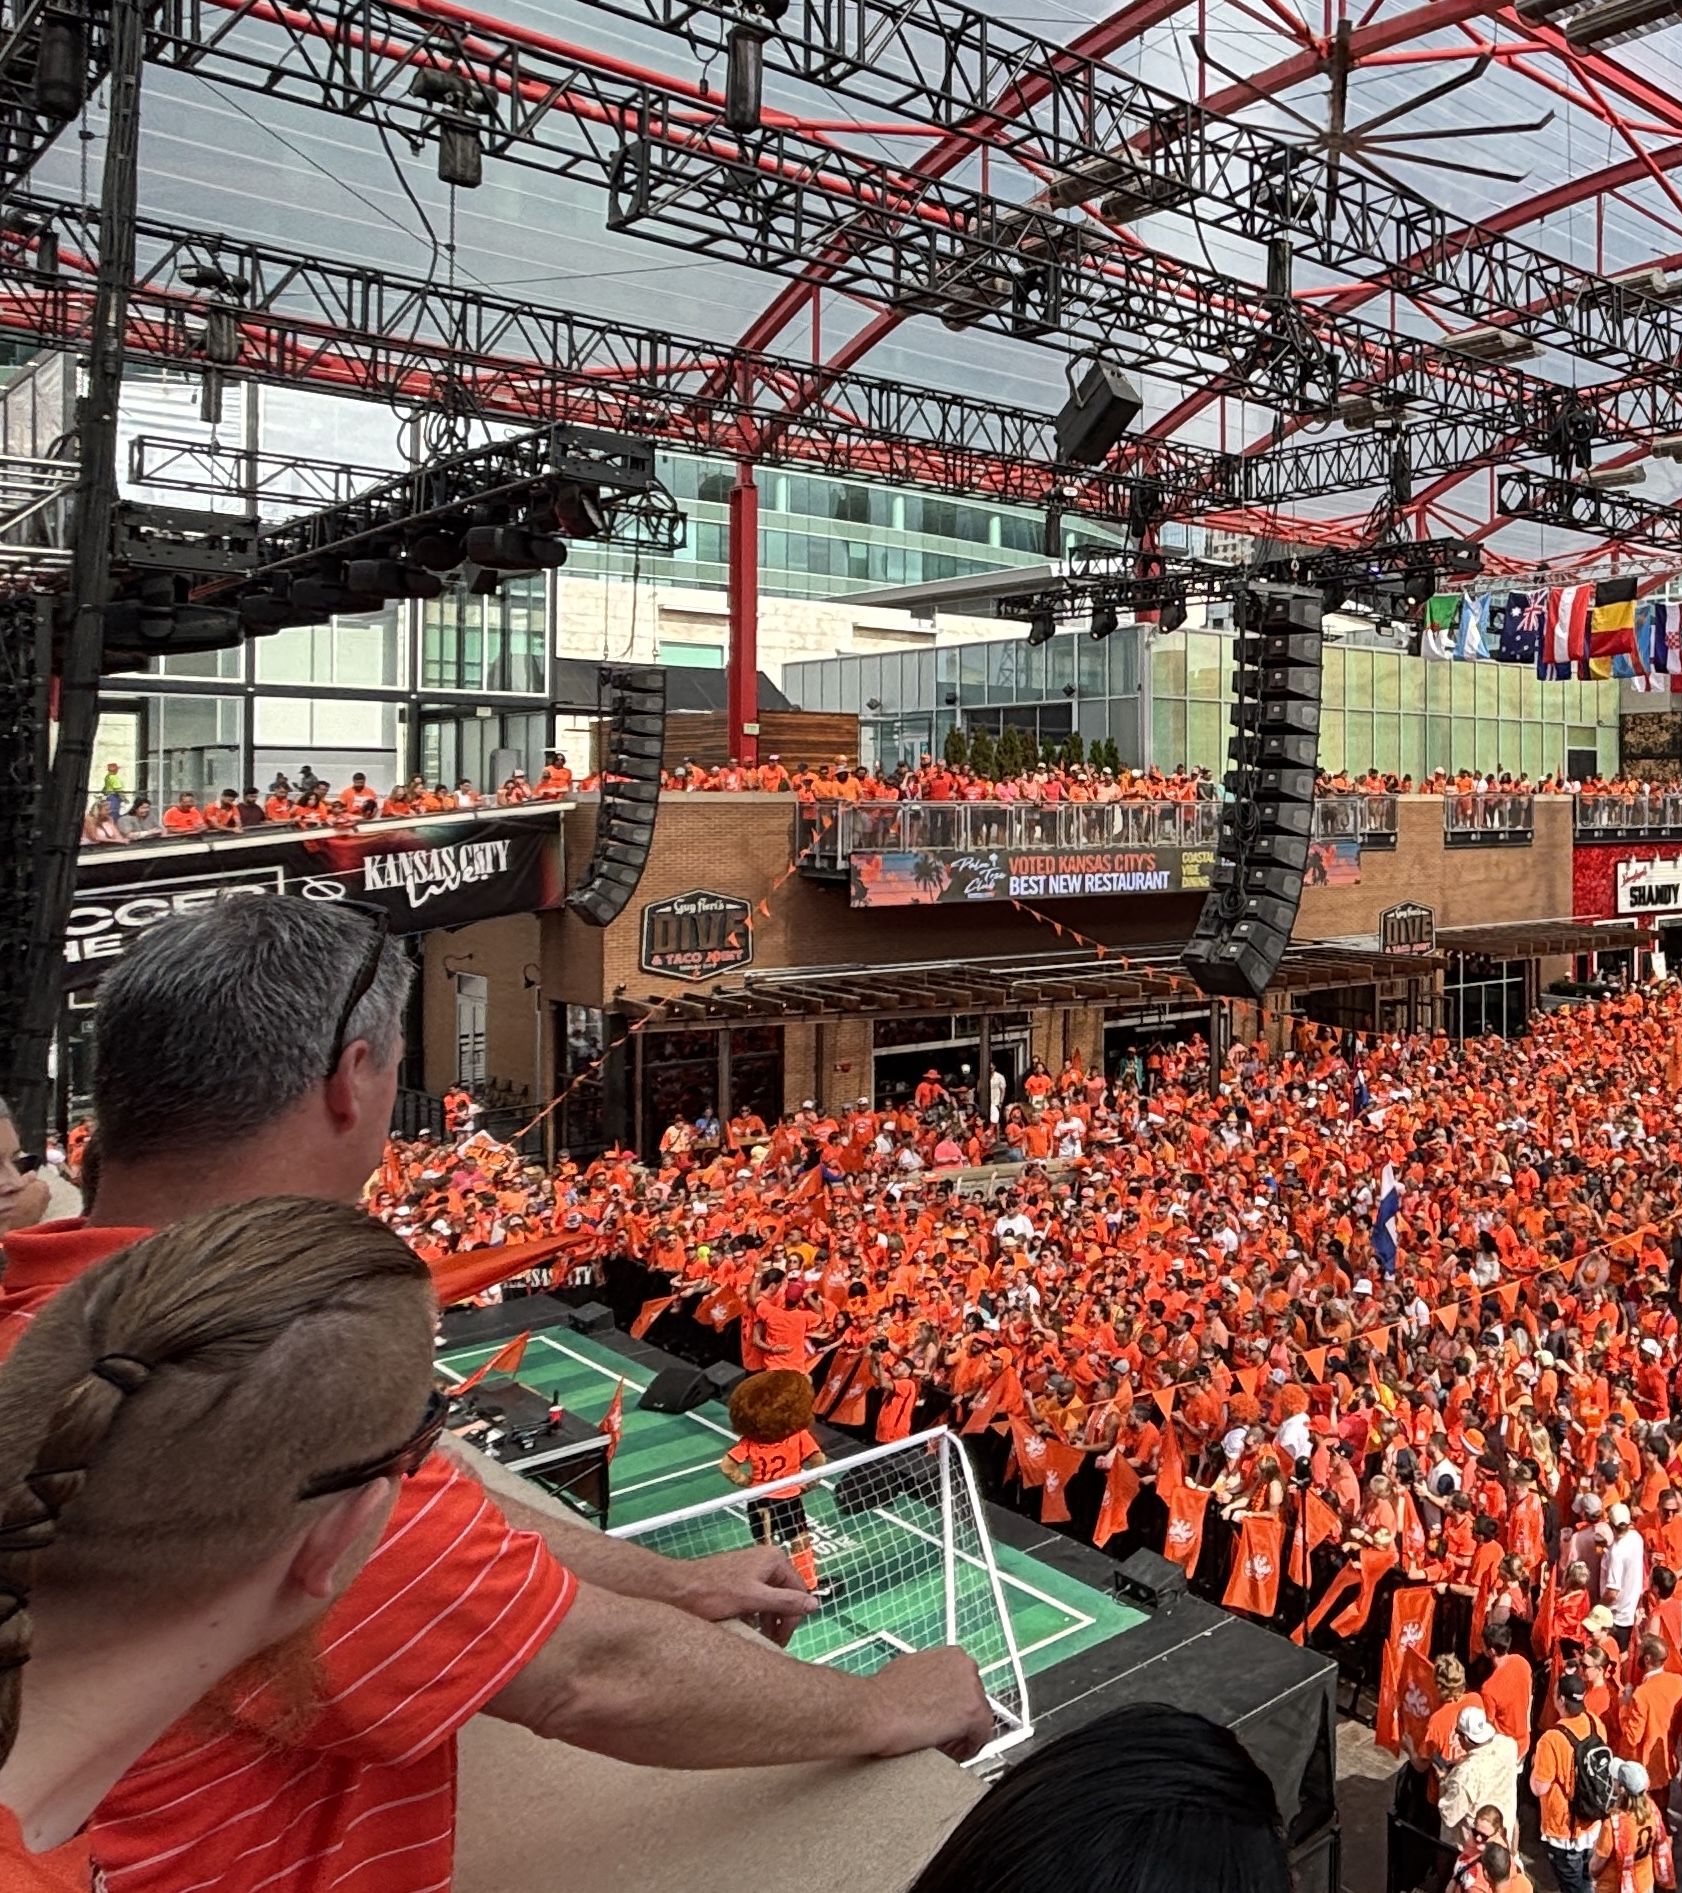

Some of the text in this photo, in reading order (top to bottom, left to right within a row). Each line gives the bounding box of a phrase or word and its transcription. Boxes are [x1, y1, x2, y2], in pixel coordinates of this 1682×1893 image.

[363, 839, 511, 891] KANSAS CITY
[1009, 853, 1156, 875] VOTED KANSAS CITY'S
[1009, 871, 1170, 896] BEST NEW RESTAURANT
[1630, 883, 1680, 907] SHANDY
[652, 911, 747, 954] DIVE
[666, 952, 702, 965] TACO
[758, 1455, 787, 1481] 12
